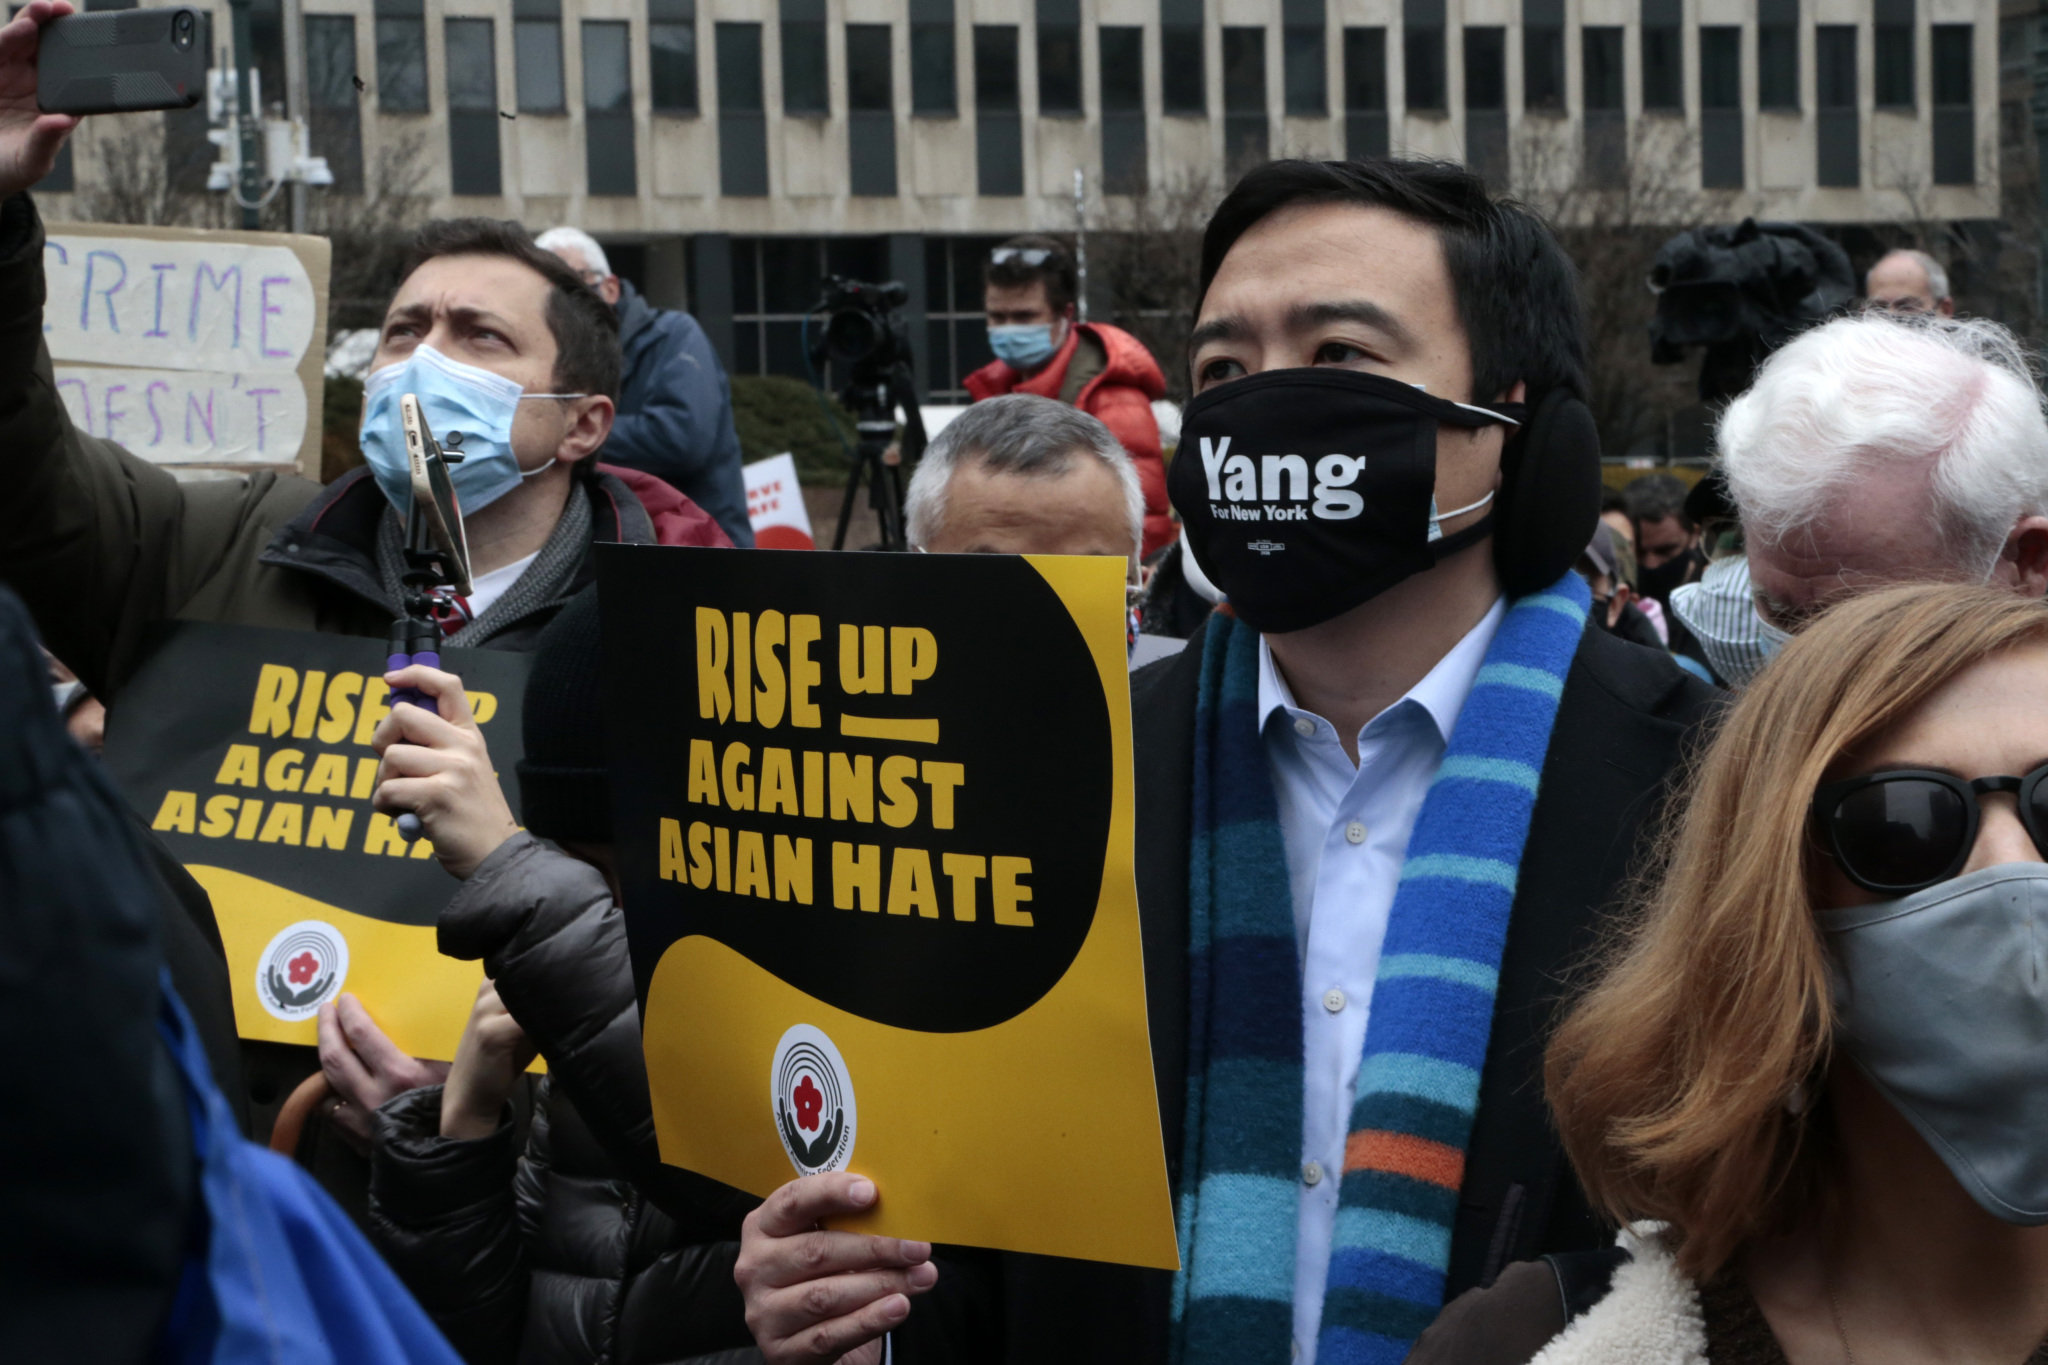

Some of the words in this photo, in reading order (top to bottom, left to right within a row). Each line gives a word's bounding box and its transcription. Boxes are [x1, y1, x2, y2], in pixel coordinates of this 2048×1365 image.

[1200, 436, 1366, 520] Yang
[1210, 503, 1229, 519] For
[1230, 504, 1260, 521] New
[1263, 504, 1308, 520] York
[249, 664, 398, 745] RISE
[696, 607, 821, 729] RISE
[152, 791, 355, 851] ASIAN
[689, 739, 964, 829] AGAINST
[660, 817, 813, 905] ASIAN
[832, 841, 1034, 927] HATE
[817, 1125, 851, 1175] Federation
